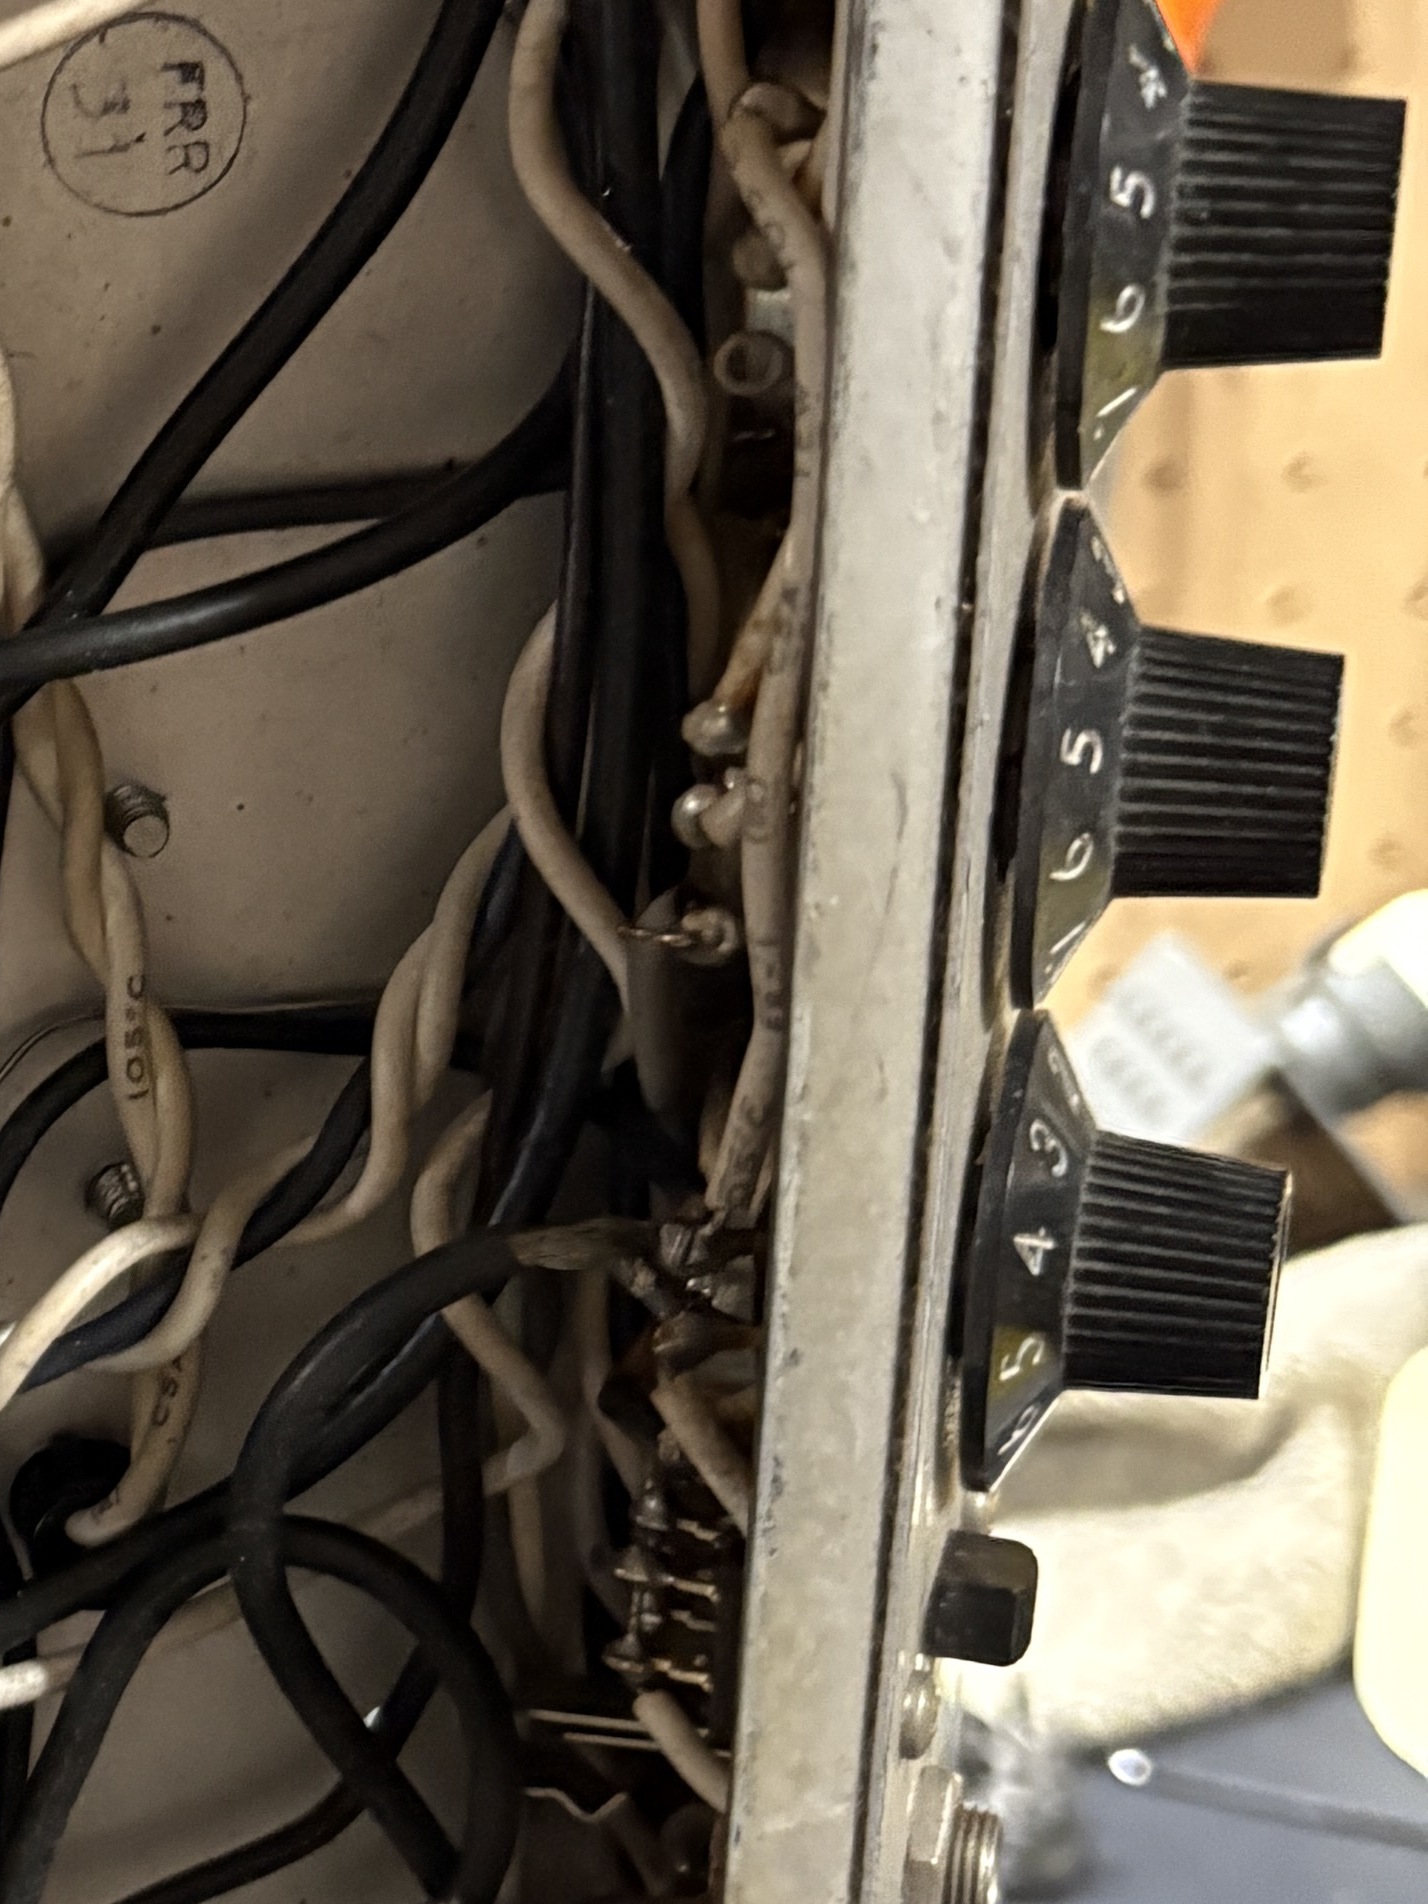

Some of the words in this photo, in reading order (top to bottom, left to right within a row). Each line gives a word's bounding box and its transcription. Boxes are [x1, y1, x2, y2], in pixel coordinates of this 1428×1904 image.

[1109, 164, 1156, 220] 5
[1099, 282, 1144, 333] 6
[1060, 726, 1104, 775] 5
[1049, 832, 1095, 882] 6
[1028, 1117, 1070, 1178] 3
[1012, 1226, 1061, 1276] 4
[998, 1333, 1046, 1382] 5
